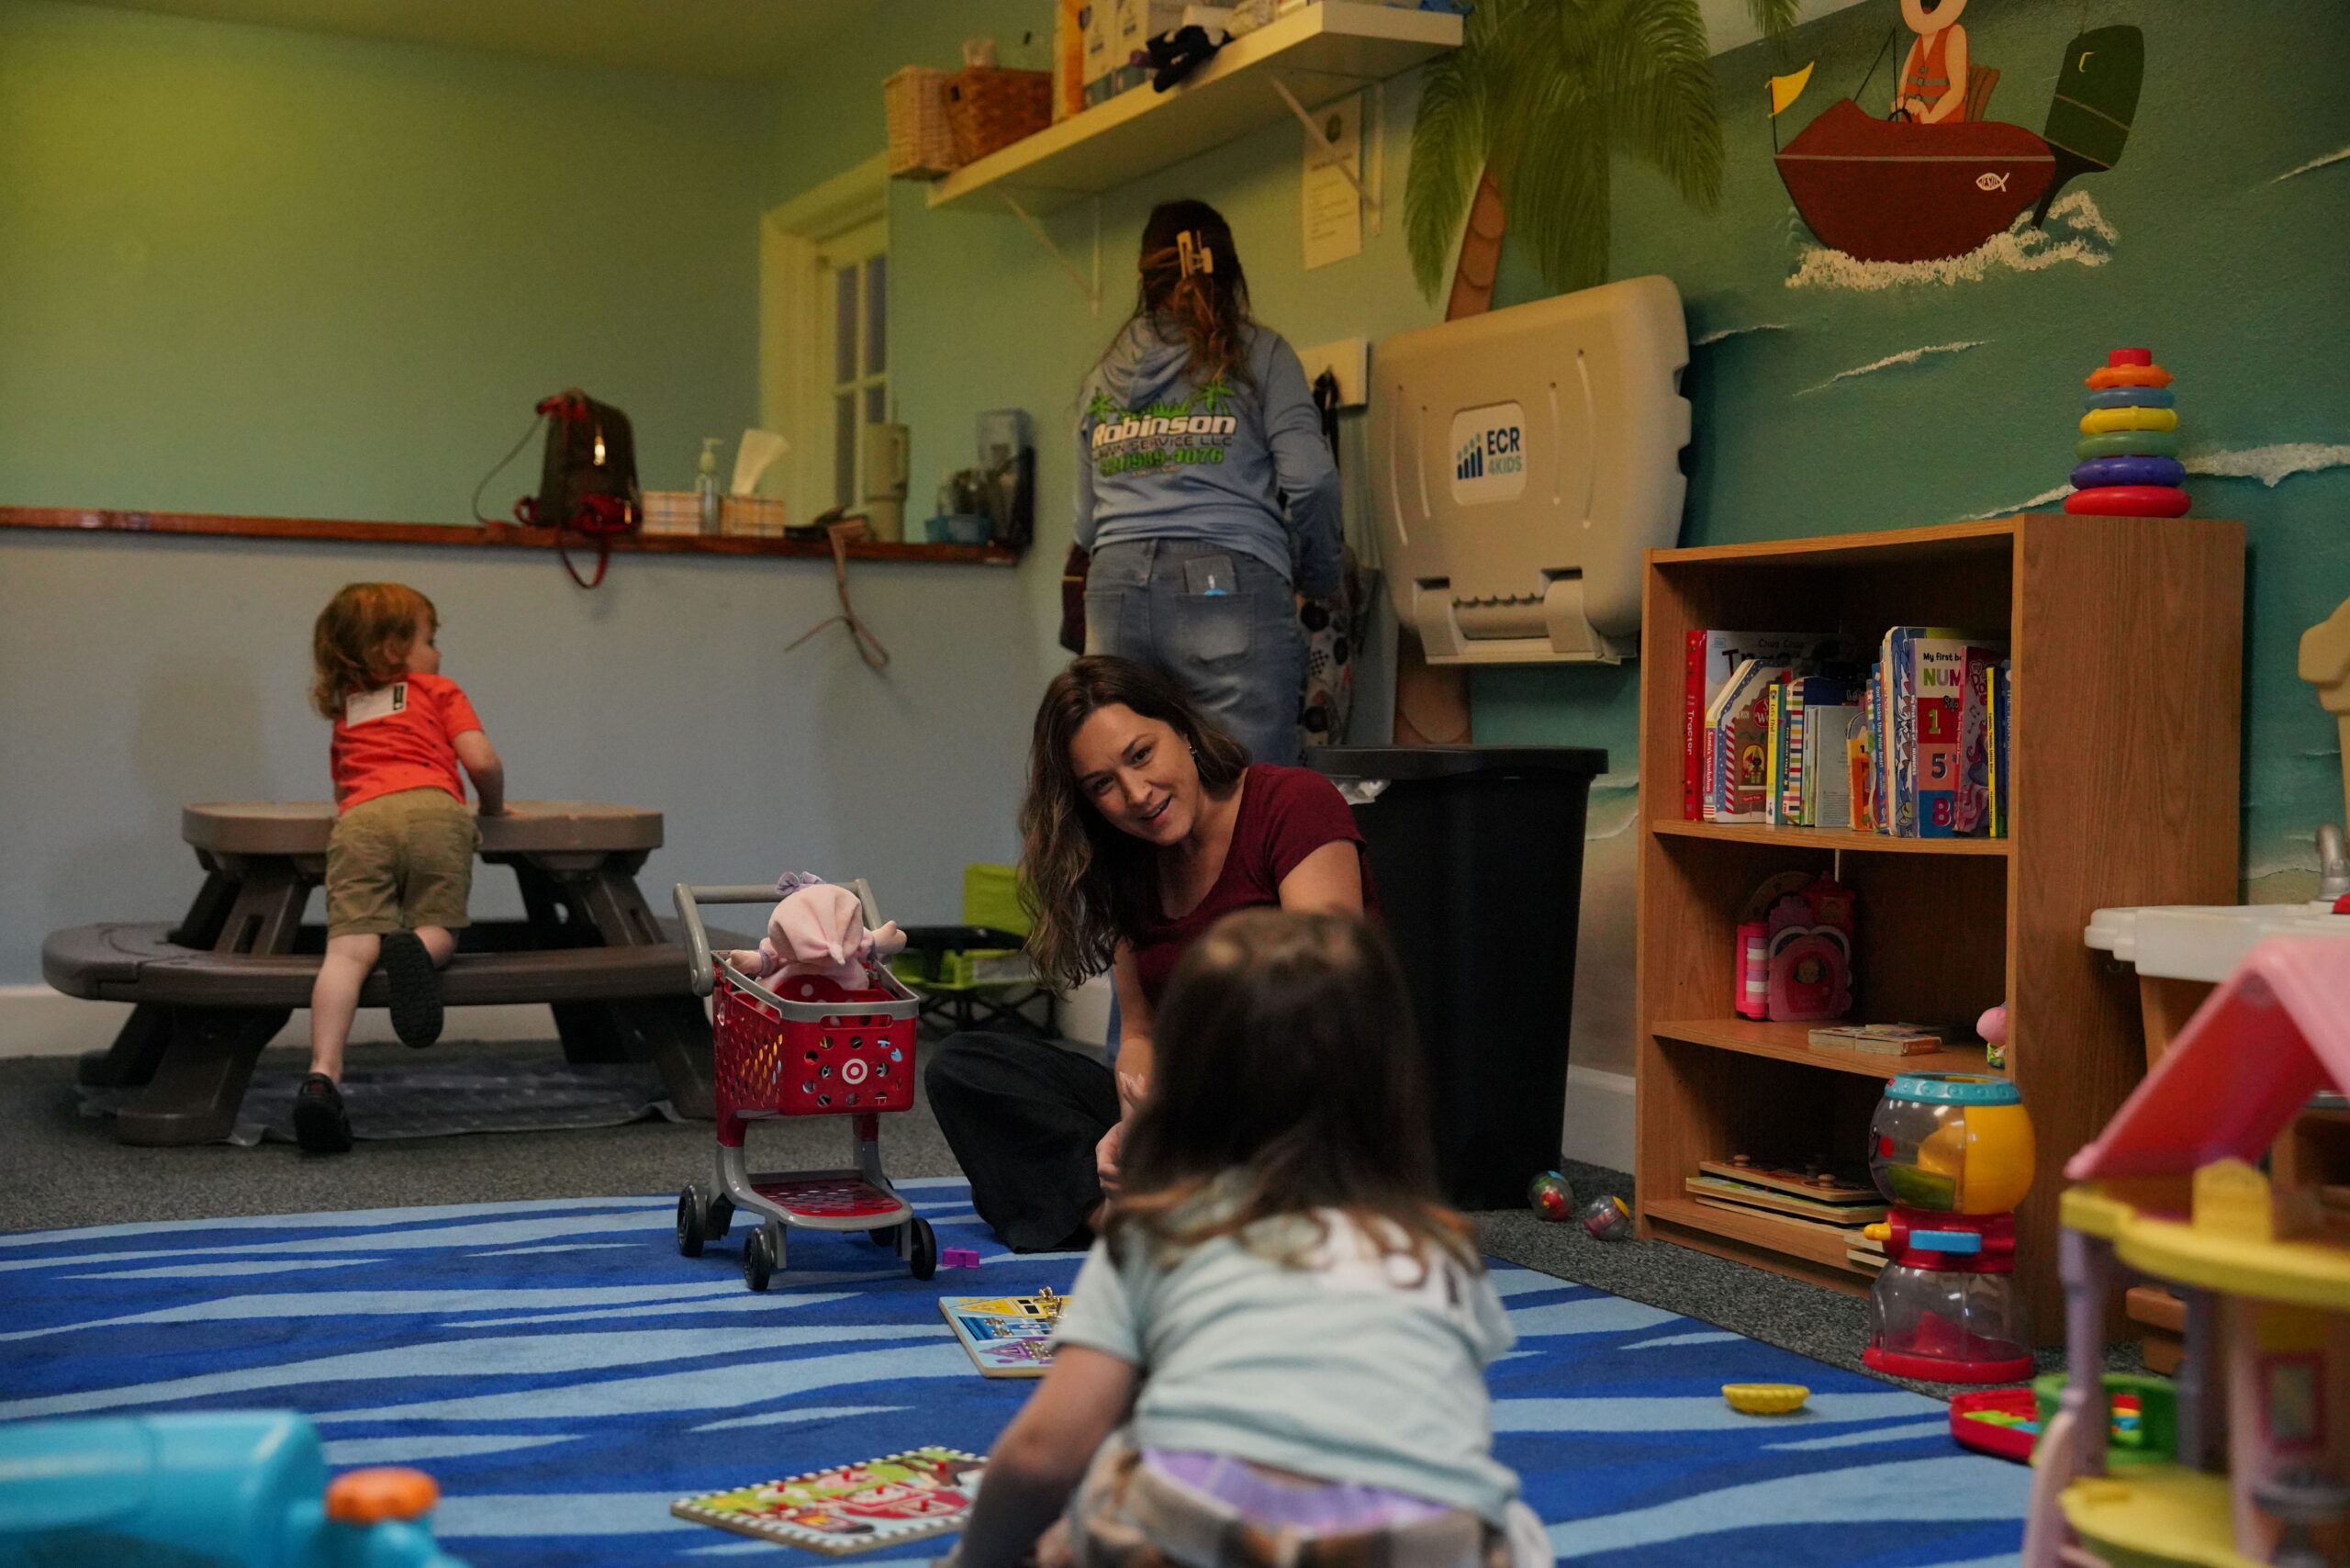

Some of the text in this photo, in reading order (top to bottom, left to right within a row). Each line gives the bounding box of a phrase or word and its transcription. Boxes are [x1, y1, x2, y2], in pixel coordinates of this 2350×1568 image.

[1091, 415, 1237, 449] Robinson
[1131, 435, 1194, 451] SERVICE
[1200, 435, 1232, 446] LLC
[1487, 427, 1520, 455] ECR
[1488, 455, 1522, 475] 4KIDS
[1923, 653, 1934, 662] My
[1936, 652, 1953, 661] first
[1923, 668, 1961, 687] NUM
[1686, 710, 1695, 756] Tractor
[1928, 708, 1941, 734] 1
[1705, 756, 1713, 791] Workshop
[1931, 753, 1948, 779] 5
[1932, 797, 1952, 826] 8
